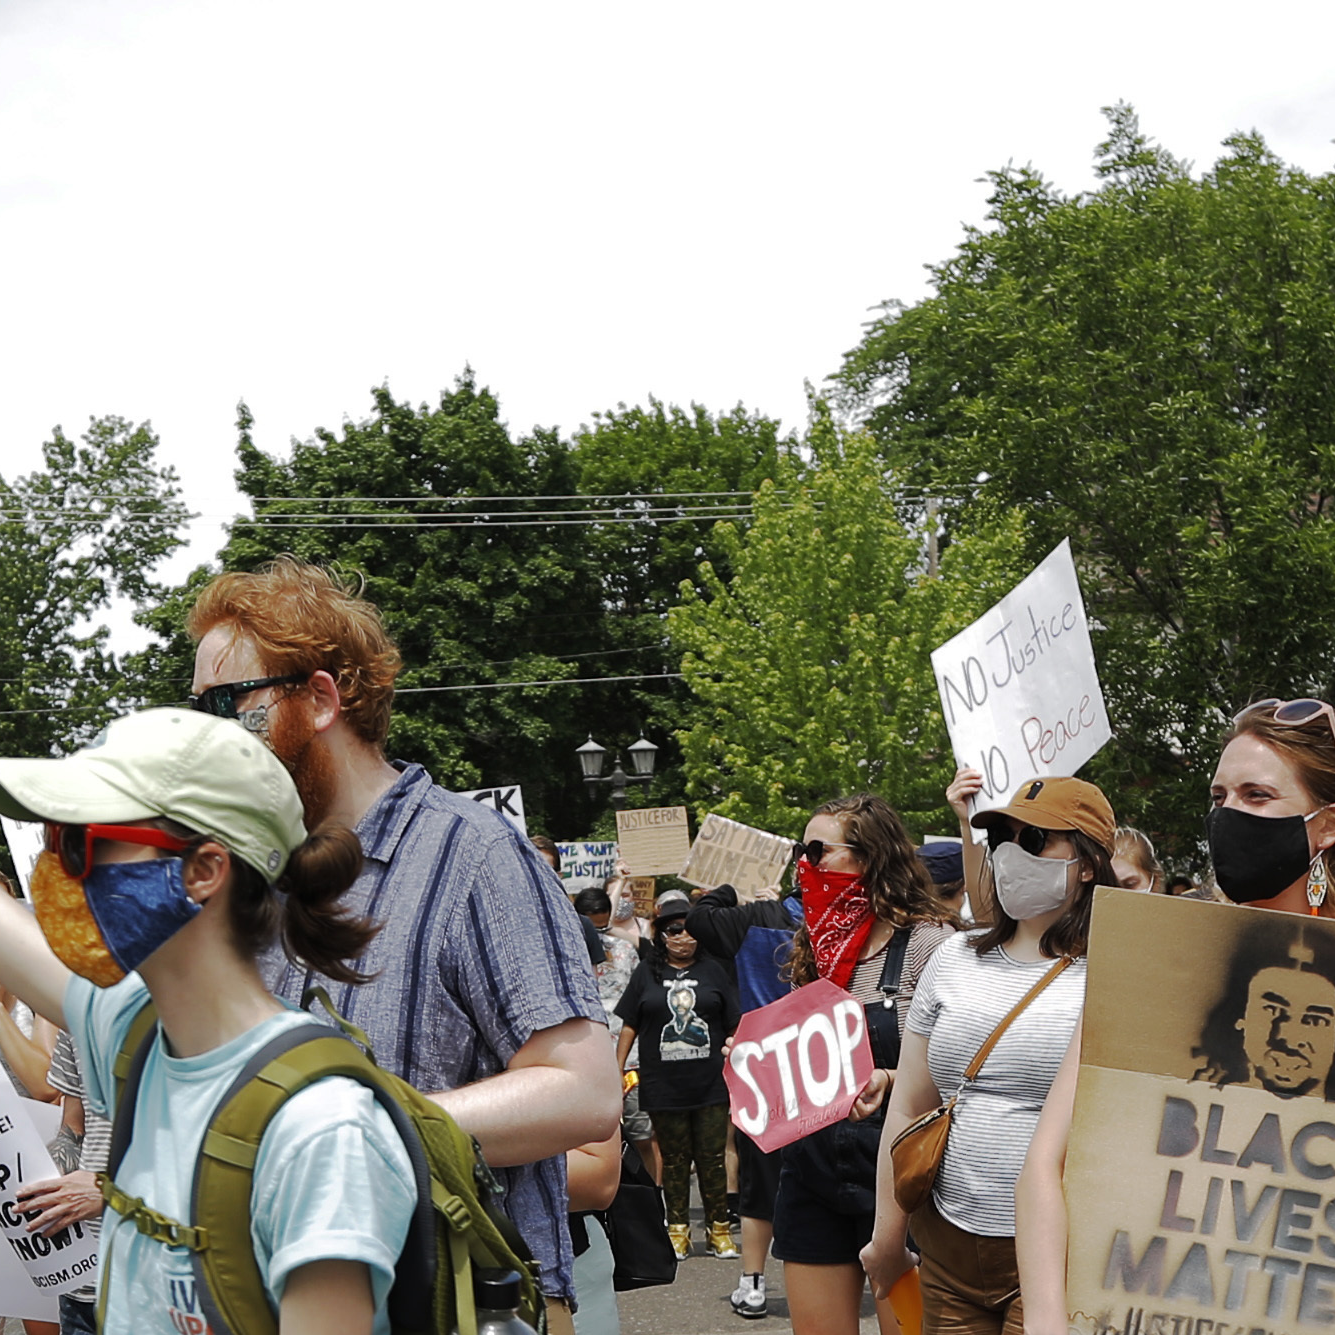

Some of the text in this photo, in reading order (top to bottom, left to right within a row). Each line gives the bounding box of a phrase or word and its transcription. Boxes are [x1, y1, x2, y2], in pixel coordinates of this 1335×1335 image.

[943, 602, 1077, 726] NO Justice
[1021, 695, 1096, 774] Peace
[619, 808, 680, 830] JUSTICE FOR
[700, 817, 791, 867] SAY THEIR
[558, 843, 614, 857] WE WANT
[562, 859, 615, 879] JUSTICE
[730, 999, 864, 1136] STOP
